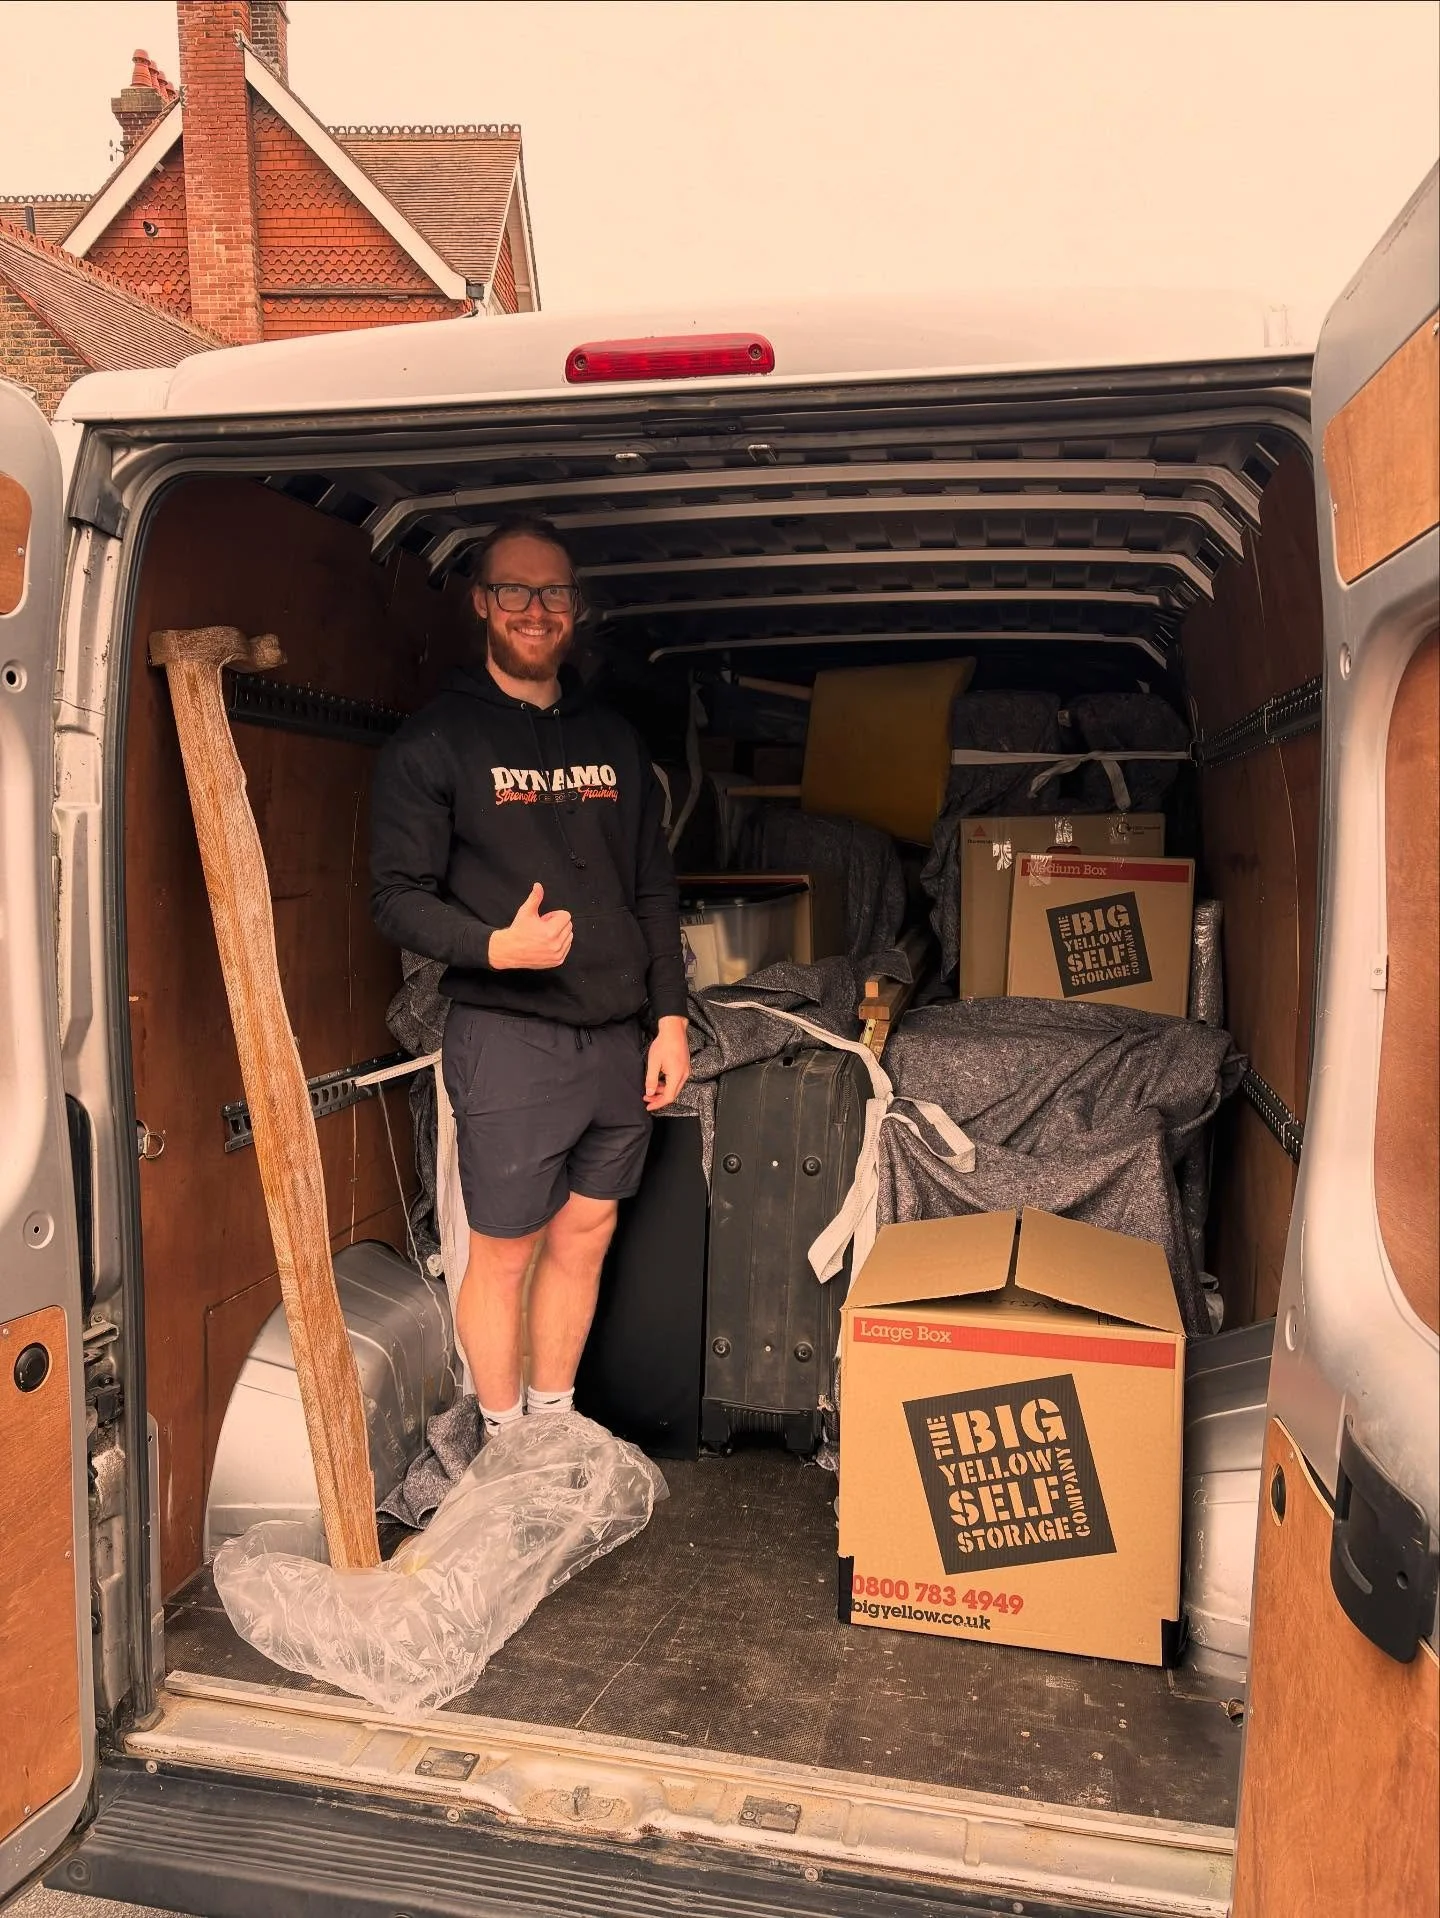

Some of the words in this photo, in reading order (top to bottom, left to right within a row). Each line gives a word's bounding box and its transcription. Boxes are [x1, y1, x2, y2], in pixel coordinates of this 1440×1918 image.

[490, 764, 617, 792] DYNAMO
[495, 788, 538, 806] Strength
[578, 784, 619, 802] Training
[1026, 861, 1080, 875] Medium
[1084, 864, 1107, 876] Box
[1058, 914, 1072, 939] THE
[1071, 904, 1130, 936] BIG
[1063, 929, 1124, 952] YELLOW
[1124, 925, 1140, 975] COMPANY
[1067, 944, 1126, 973] SELF
[1071, 964, 1131, 987] STORAGE
[860, 1320, 913, 1342] Large
[917, 1326, 952, 1344] Box
[926, 1414, 954, 1461] THE
[951, 1398, 1068, 1456] BIG
[938, 1448, 1056, 1487] YELLOW
[948, 1475, 1061, 1527] SELF
[1054, 1445, 1091, 1538] COMPANY
[957, 1516, 1074, 1554] STORAGE
[852, 1574, 909, 1600] 0800
[914, 1582, 957, 1607] 783
[962, 1589, 1024, 1615] 4949
[851, 1598, 991, 1630] bigyellow.co.uk
